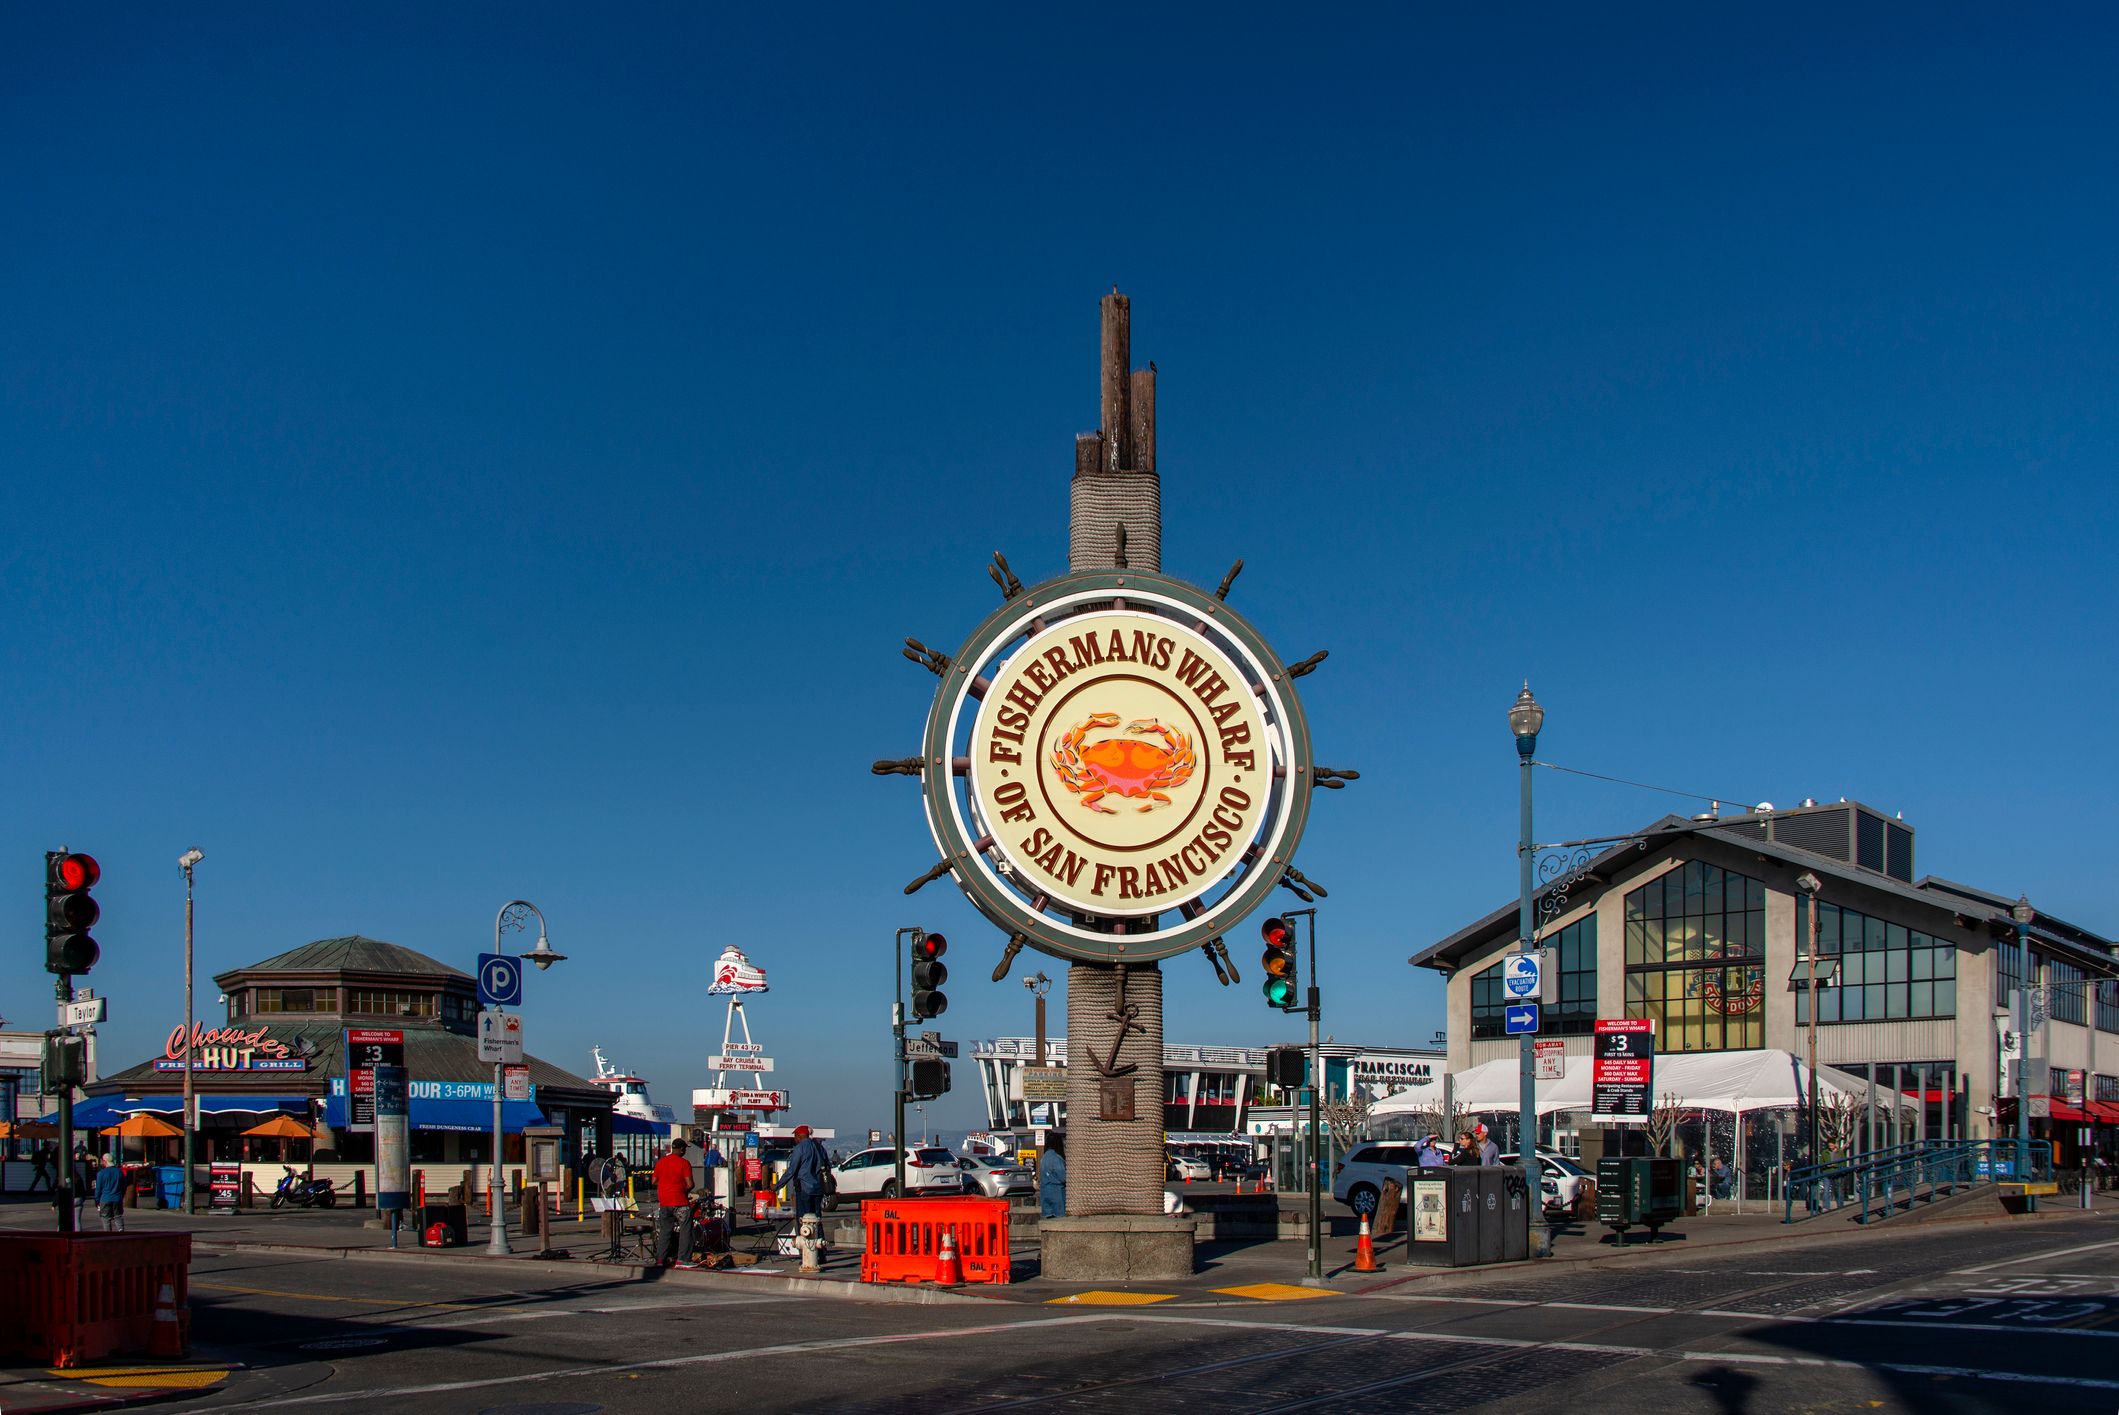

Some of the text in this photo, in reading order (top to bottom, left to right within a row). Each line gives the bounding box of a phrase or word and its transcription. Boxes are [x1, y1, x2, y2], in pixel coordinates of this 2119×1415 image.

[990, 628, 1256, 772] FISHERMANS WHARF
[993, 781, 1251, 899] OF SAN FRANCISCO
[1509, 976, 1536, 986] EVACUATION
[74, 1006, 96, 1021] Taylor
[166, 1021, 291, 1060] Chowder
[1611, 1035, 1628, 1051] $3
[366, 1045, 382, 1062] $3
[910, 1043, 954, 1054] Jefferson
[203, 1047, 256, 1069] HUT
[1354, 1062, 1430, 1076] FRANCISCAN
[444, 1084, 481, 1098] 3-6PM
[884, 1210, 900, 1220] BAL
